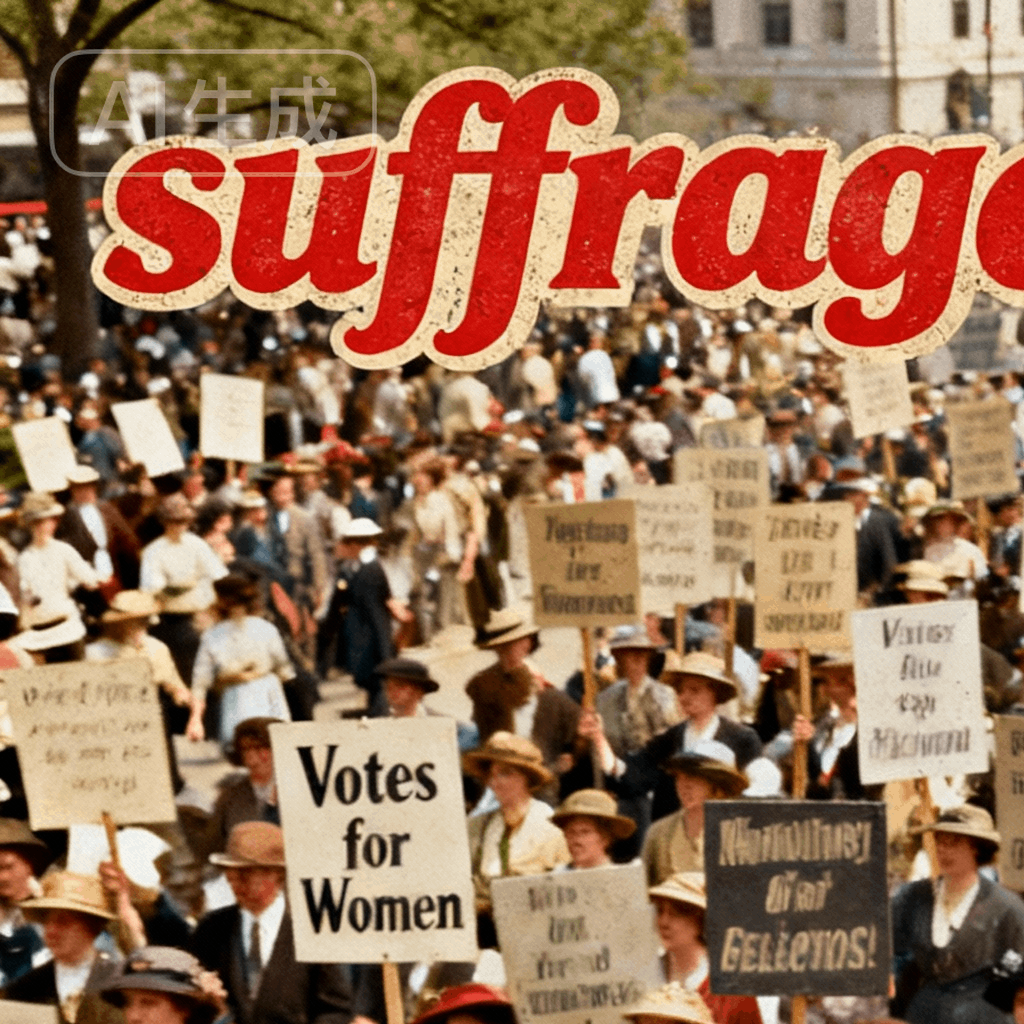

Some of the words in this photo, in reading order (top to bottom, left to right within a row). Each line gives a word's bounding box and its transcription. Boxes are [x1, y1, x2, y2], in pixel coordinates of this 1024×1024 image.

[297, 745, 437, 807] Votes
[343, 817, 410, 870] for
[301, 878, 463, 933] Women
